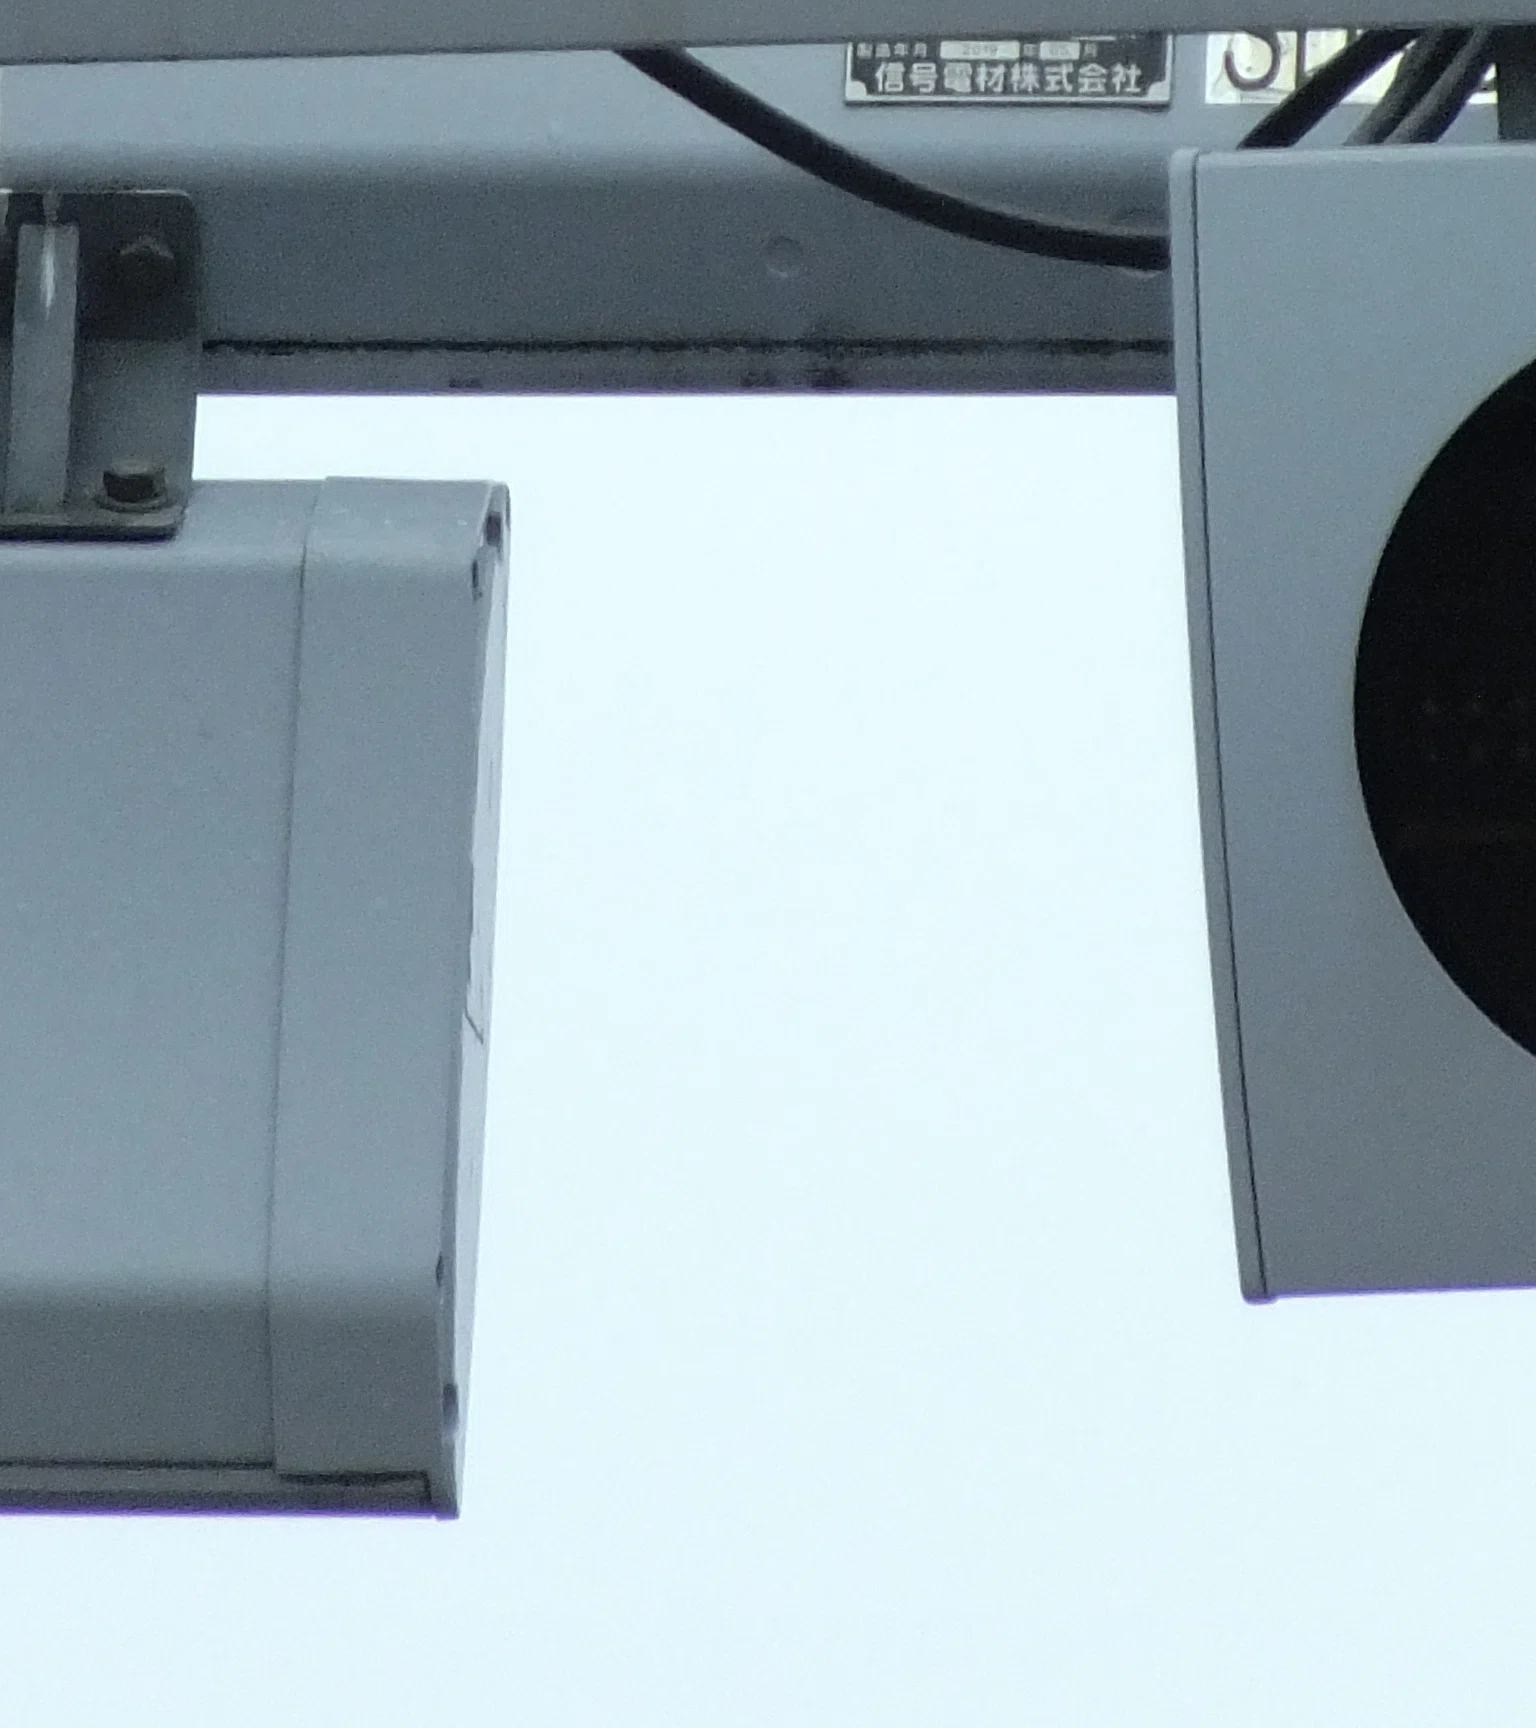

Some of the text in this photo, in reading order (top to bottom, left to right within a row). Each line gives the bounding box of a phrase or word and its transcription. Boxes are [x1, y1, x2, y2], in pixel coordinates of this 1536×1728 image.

[875, 61, 1143, 93] 信号電材株式会社
